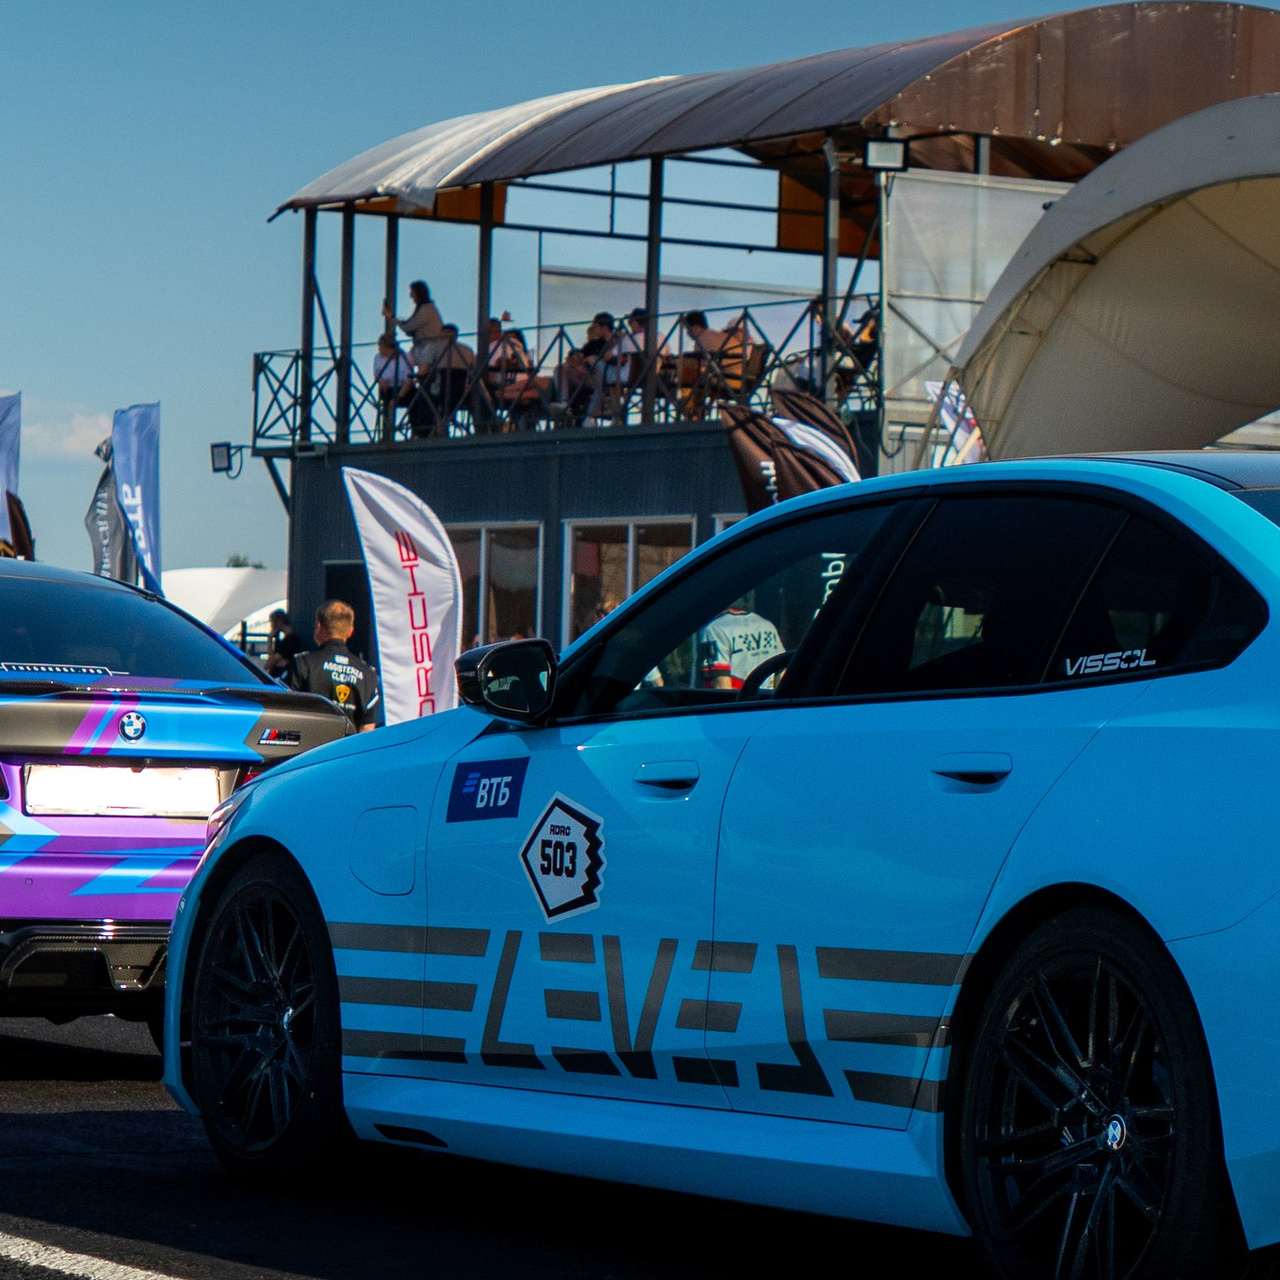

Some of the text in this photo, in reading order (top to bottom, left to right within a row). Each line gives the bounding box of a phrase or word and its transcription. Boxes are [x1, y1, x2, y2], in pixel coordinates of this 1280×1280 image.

[394, 530, 436, 718] ORSCHE
[1065, 648, 1157, 676] VISSOL
[476, 776, 512, 808] ВТБ
[549, 824, 571, 837] RDRC
[539, 839, 578, 878] 503
